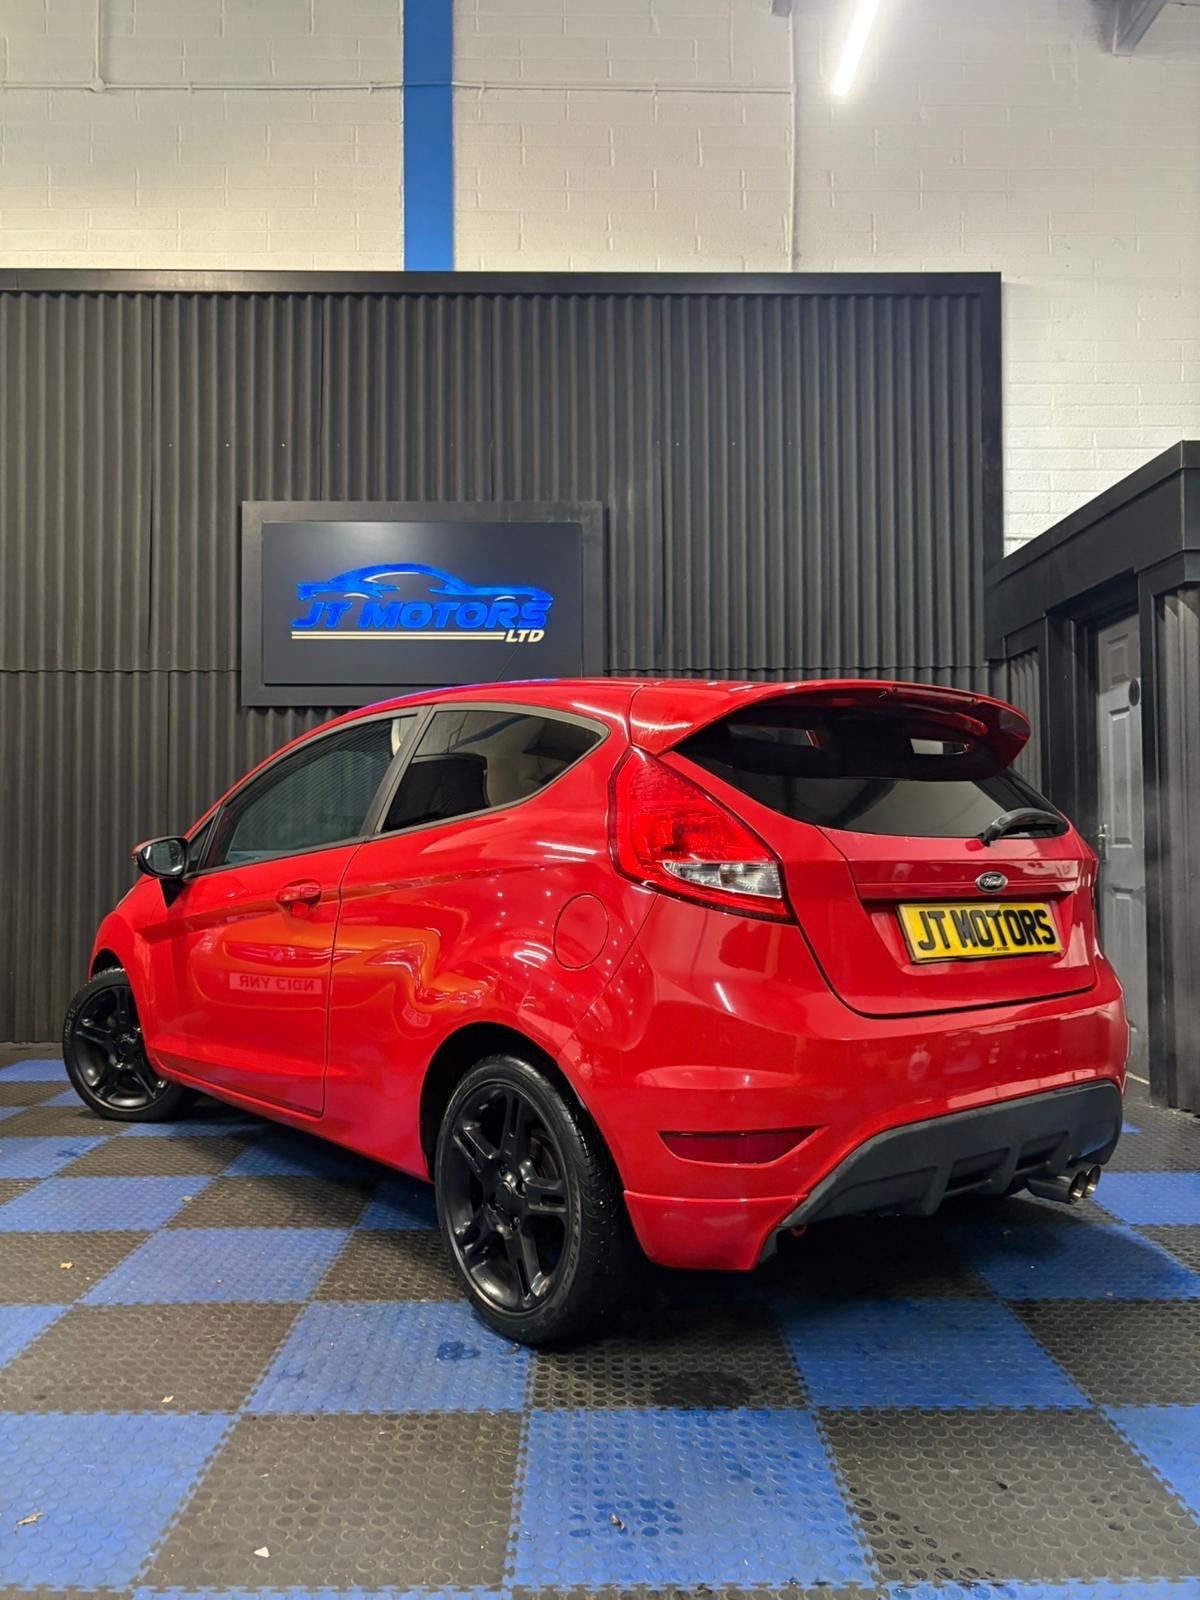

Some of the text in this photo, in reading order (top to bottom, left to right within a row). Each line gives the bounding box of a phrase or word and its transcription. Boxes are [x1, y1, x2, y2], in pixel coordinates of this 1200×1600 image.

[291, 601, 551, 629] JT MOTORS
[505, 629, 545, 643] LTD
[917, 909, 1056, 950] JT MOTORS
